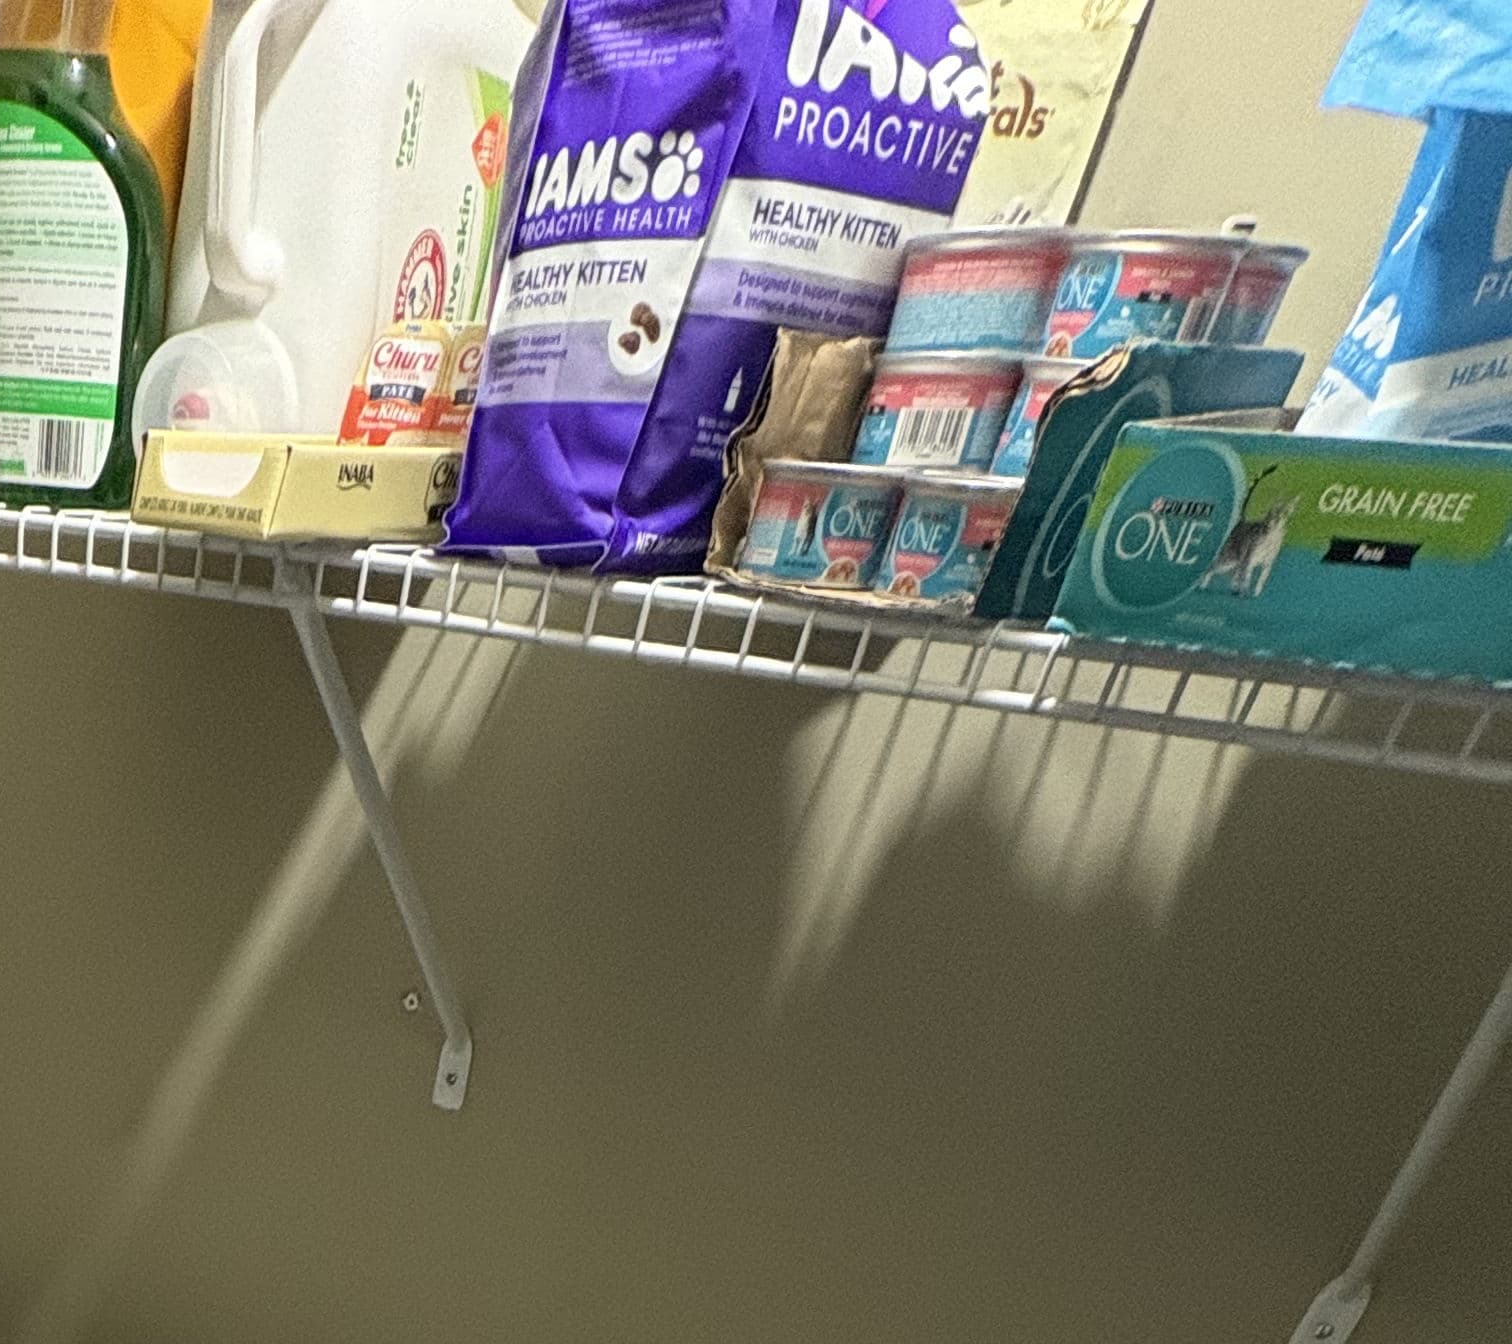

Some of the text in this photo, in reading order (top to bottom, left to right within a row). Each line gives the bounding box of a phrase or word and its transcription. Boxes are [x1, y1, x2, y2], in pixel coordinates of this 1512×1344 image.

[773, 96, 973, 175] PROACTIVE
[526, 132, 653, 219] IAMS
[456, 183, 473, 256] skin
[520, 206, 692, 243] PROACTIVE HEALTH
[749, 229, 777, 246] WITH
[753, 198, 902, 250] HEALTHY KITTEN
[577, 259, 648, 286] KITTEN
[1057, 273, 1105, 310] ONE
[373, 340, 440, 372] Churu
[378, 401, 422, 425] Kitten
[338, 463, 374, 483] INABA
[830, 505, 880, 538] ONE
[1318, 483, 1476, 523] GRAIN FREE
[899, 516, 951, 554] ONE
[1115, 511, 1213, 565] ONE
